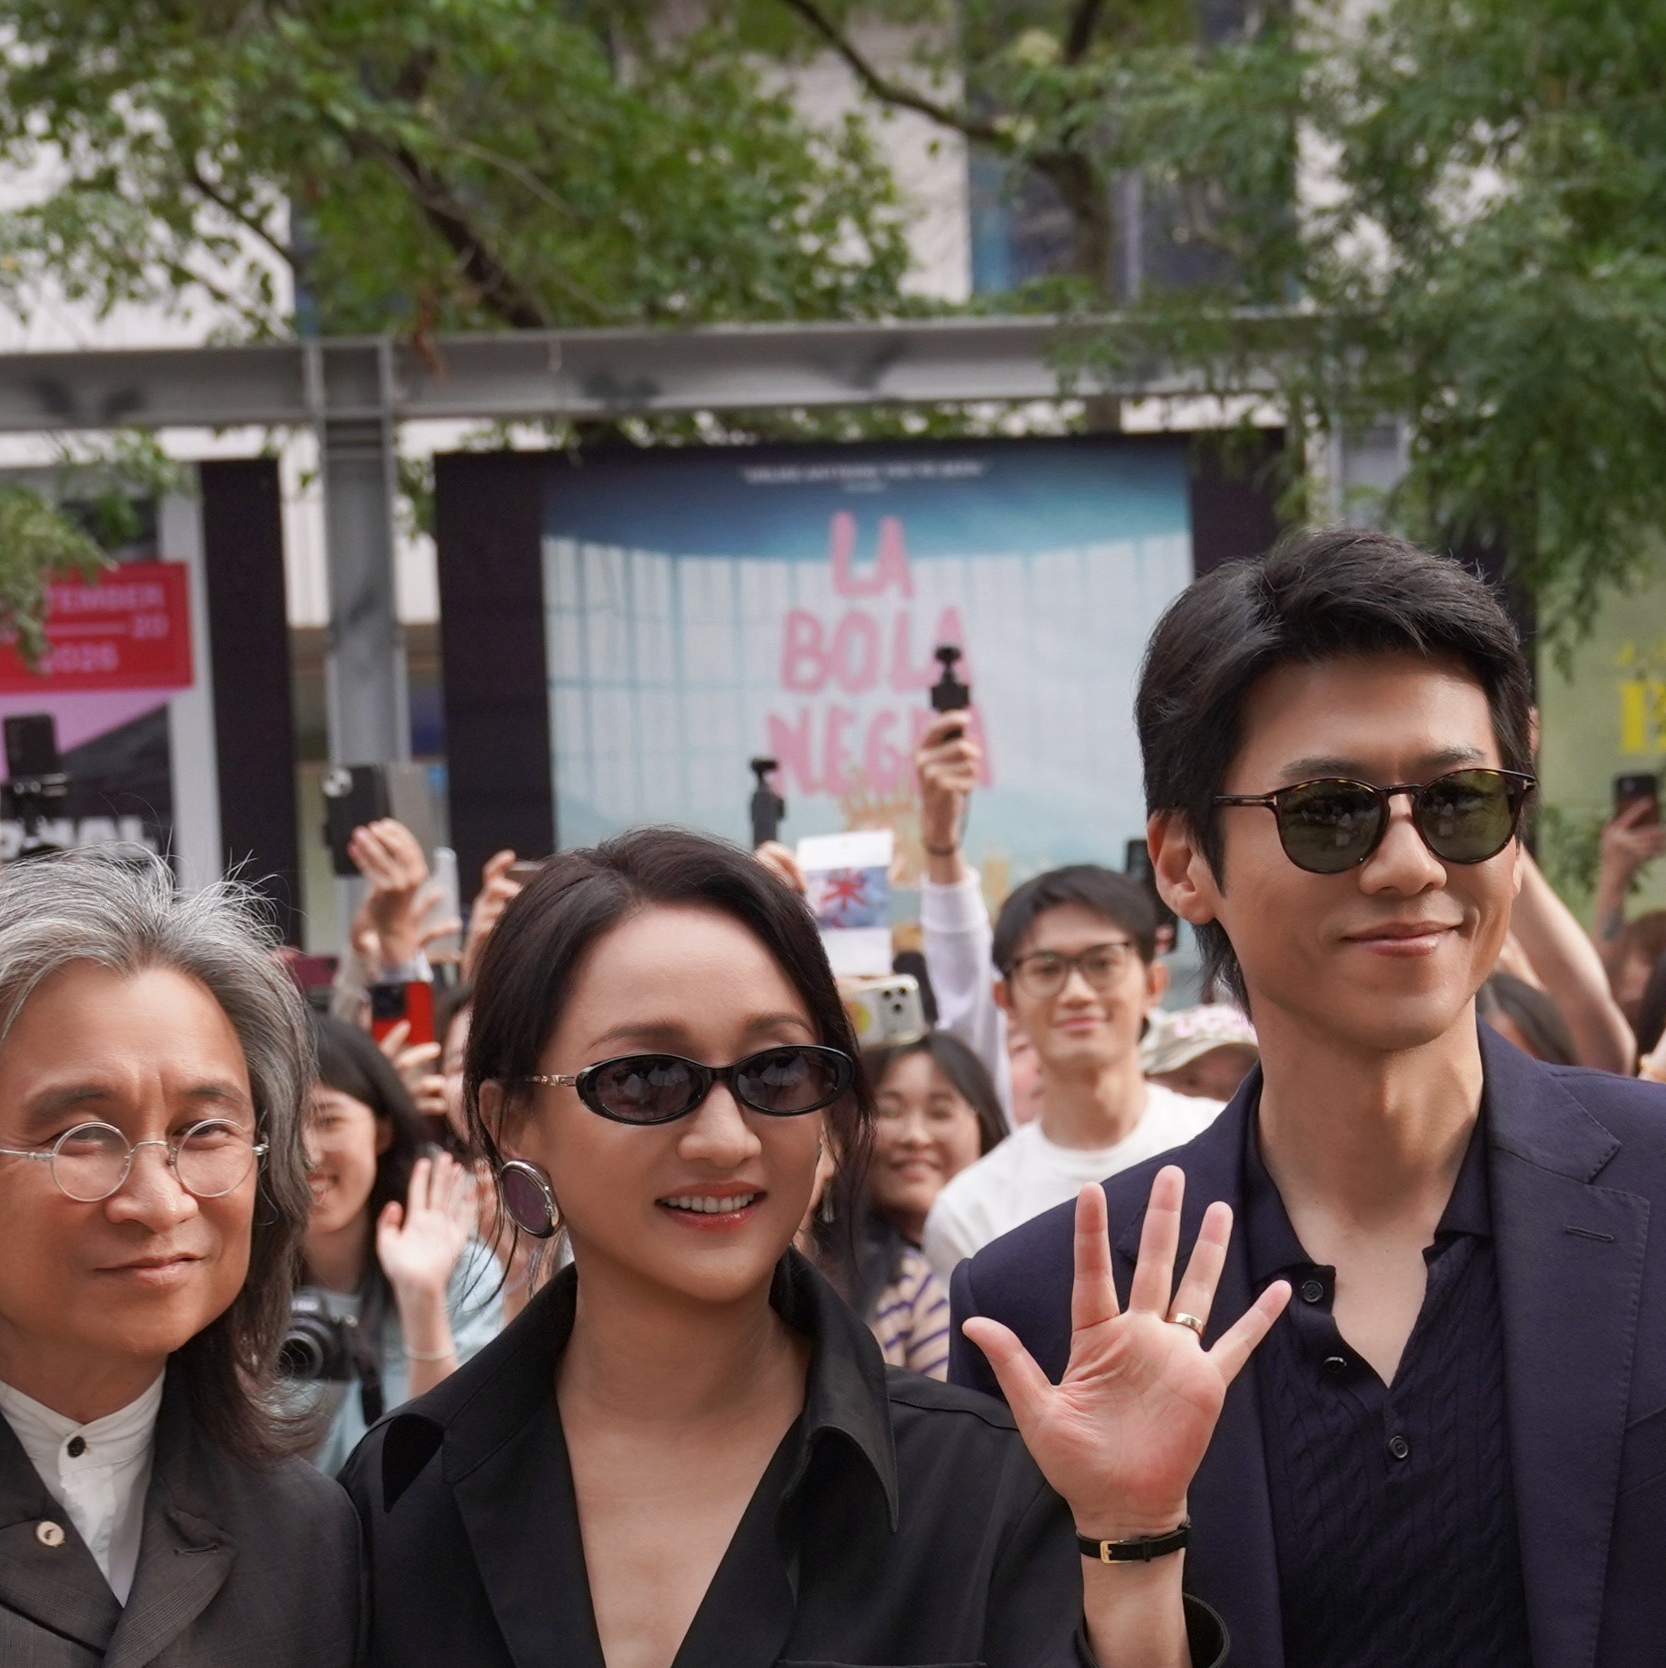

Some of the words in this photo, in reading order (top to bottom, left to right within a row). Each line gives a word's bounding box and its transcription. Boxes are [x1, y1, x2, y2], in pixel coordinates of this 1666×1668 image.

[829, 511, 916, 600] LA
[781, 605, 974, 696] BOLA
[764, 702, 993, 801] NEG
